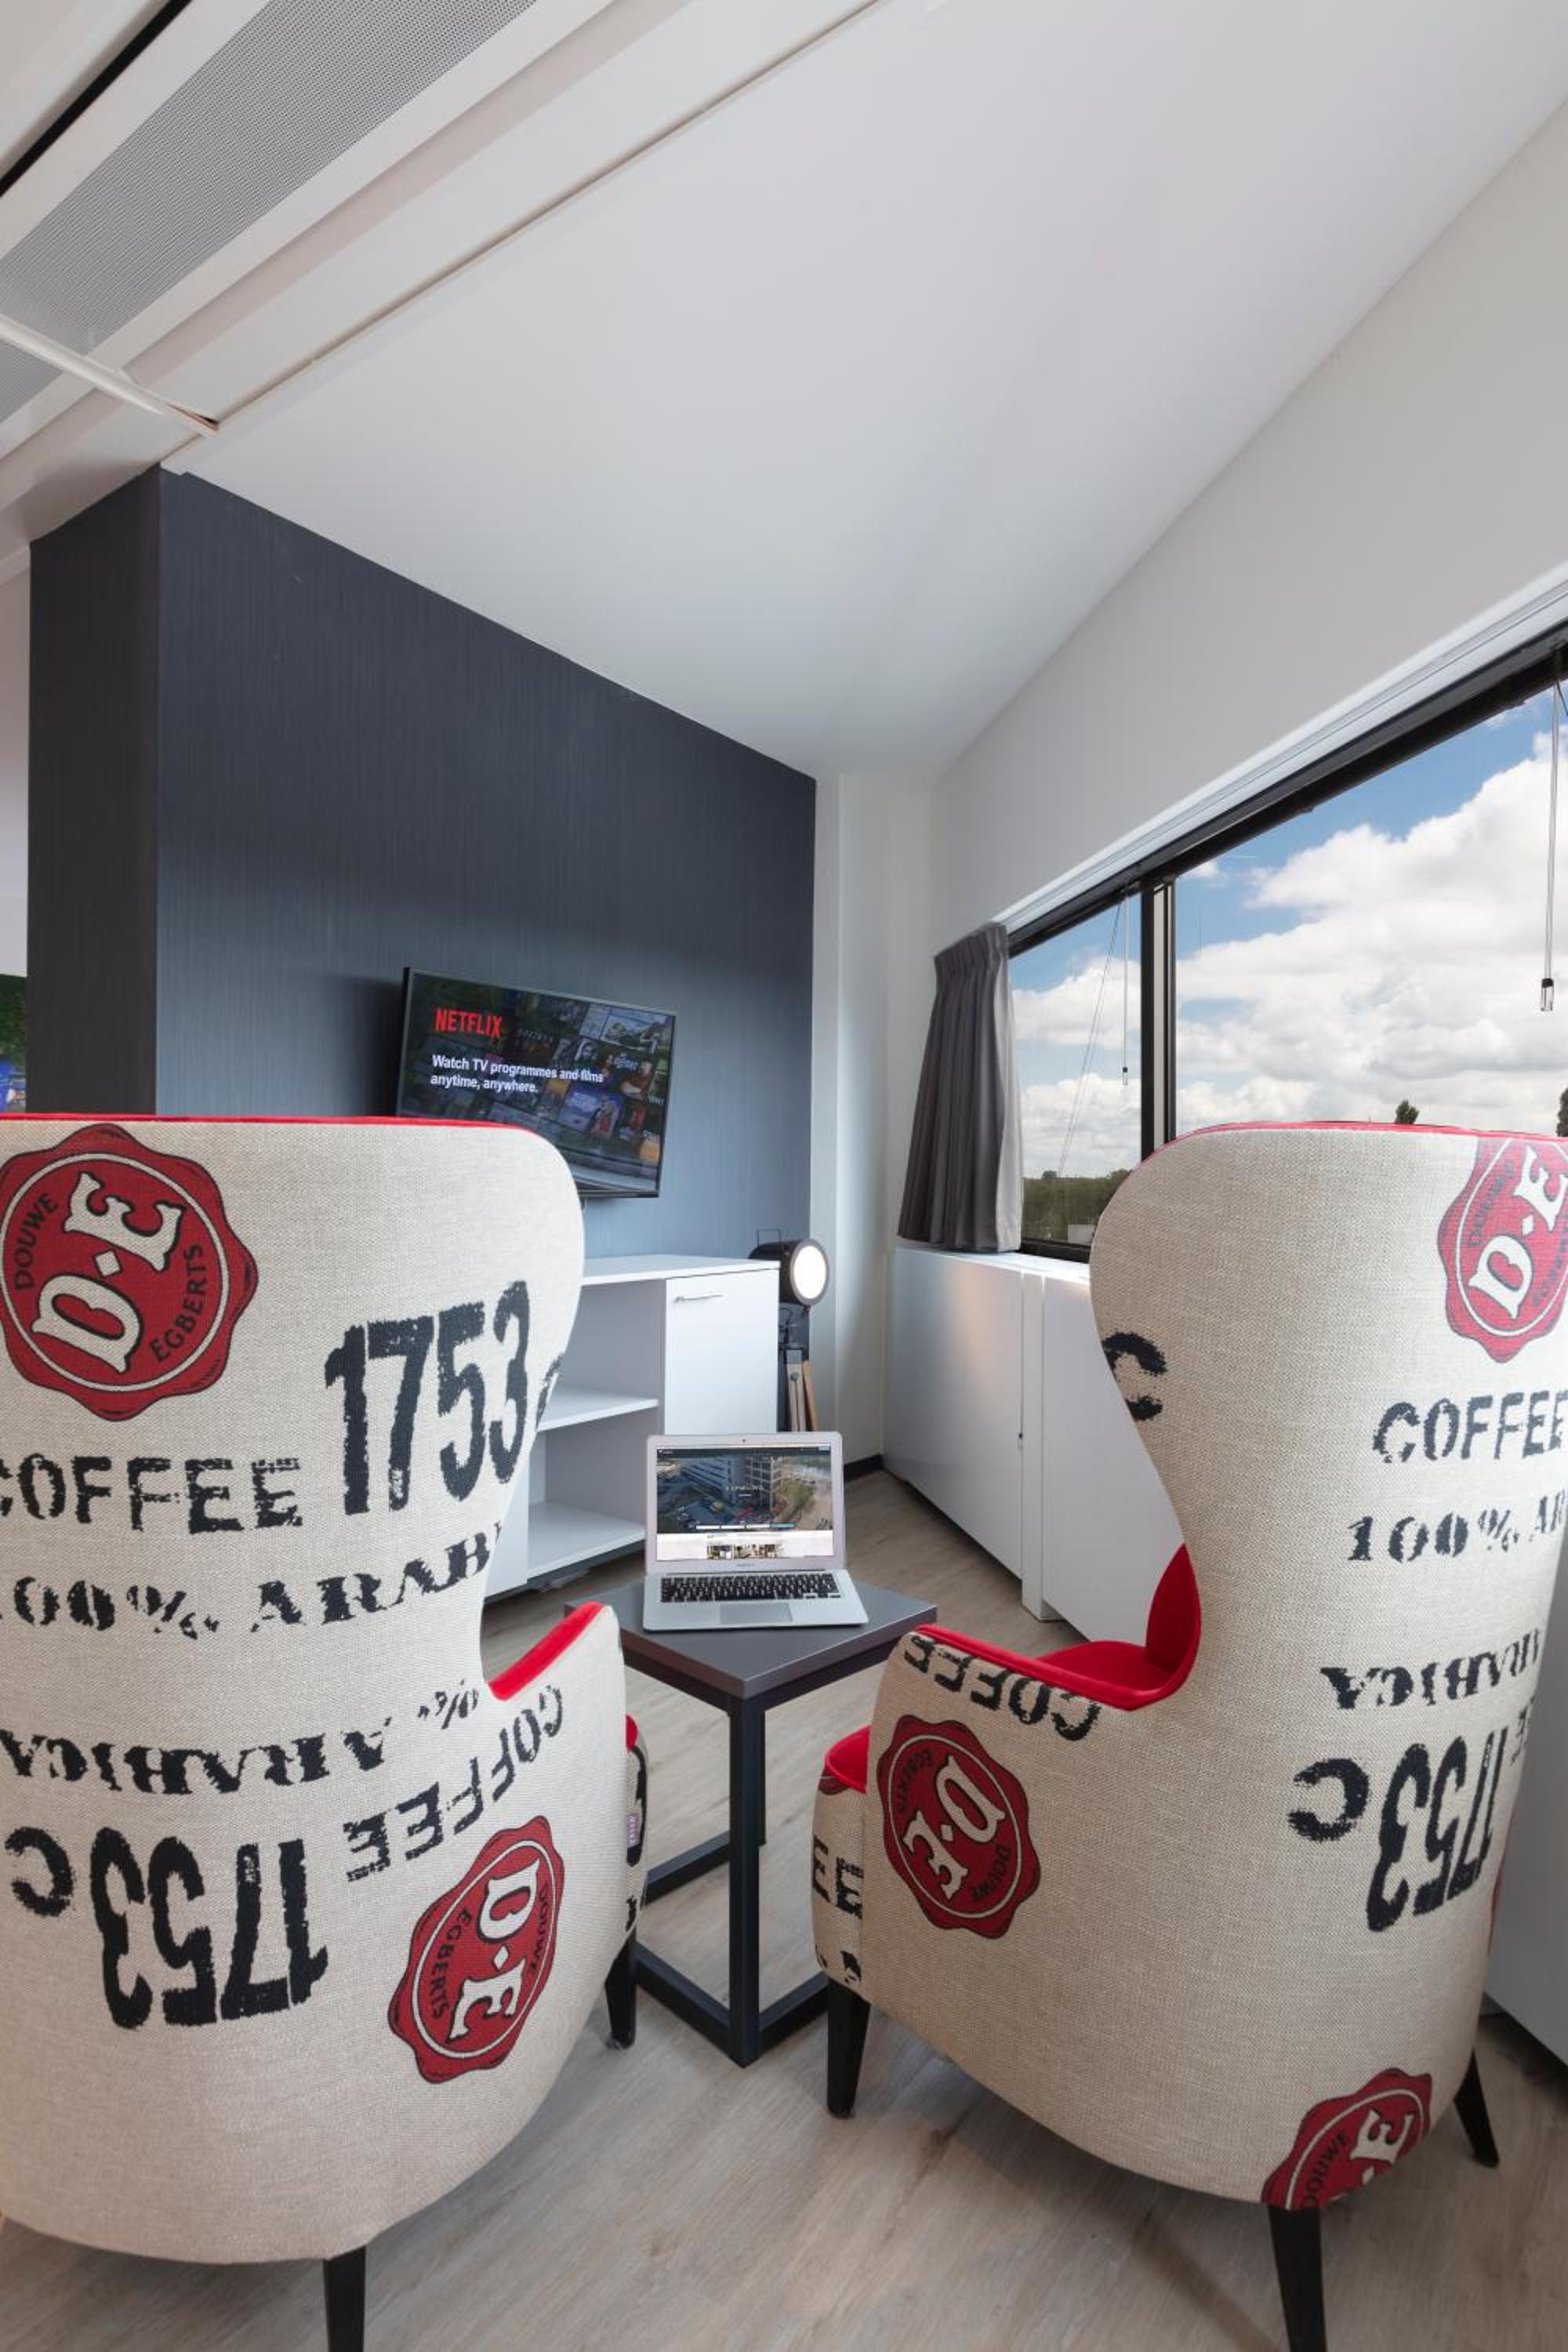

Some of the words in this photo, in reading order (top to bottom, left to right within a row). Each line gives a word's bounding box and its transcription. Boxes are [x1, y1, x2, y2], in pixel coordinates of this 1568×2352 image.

[432, 1054, 470, 1070] Watch
[473, 1058, 488, 1071] TV
[490, 1063, 557, 1079] programmes
[559, 1069, 579, 1080] and
[580, 1069, 604, 1083] films
[434, 1007, 503, 1038] NETFLIX
[430, 1074, 481, 1091] anytime,
[483, 1079, 539, 1094] anywhere.
[15, 1192, 60, 1292] DOUWE
[149, 1243, 209, 1363] EGBERTS
[325, 1279, 531, 1515] 1753
[0, 1452, 303, 1534] OFFEE
[1347, 1508, 1519, 1563] 100%
[0, 1576, 220, 1640] 00%
[343, 1684, 564, 1882] COFFEE
[1366, 1725, 1508, 1933] 1753
[3, 1826, 77, 1918] C
[89, 1826, 329, 2031] 1753
[428, 1907, 473, 2020] EGBERTS
